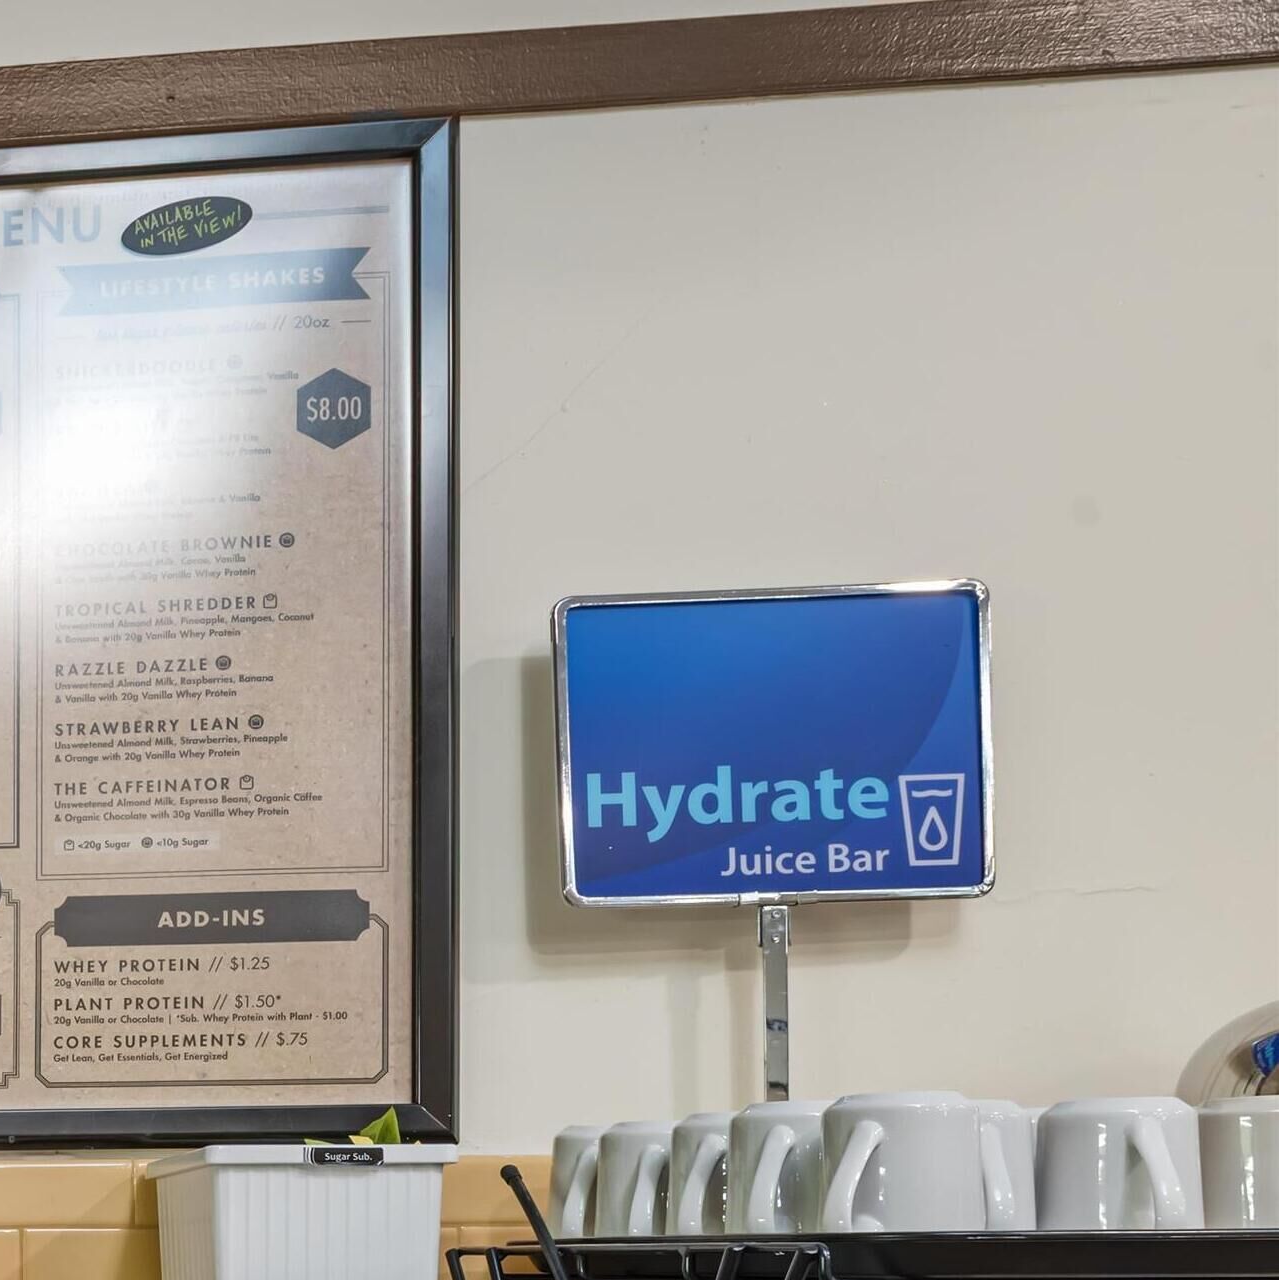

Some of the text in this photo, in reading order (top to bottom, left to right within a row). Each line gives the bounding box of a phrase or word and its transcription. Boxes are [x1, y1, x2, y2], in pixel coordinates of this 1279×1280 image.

[134, 199, 216, 235] AVAILABLE
[140, 204, 242, 249] IN THE VIEW!
[101, 267, 326, 298] LIFESTYLE SHAKES
[293, 315, 331, 329] 20oz
[306, 396, 362, 422] $8.00
[180, 535, 273, 552] BROWNIE
[55, 597, 256, 617] TROPICAL SHREDDER
[55, 658, 209, 677] RAZZLE DAZZLE
[55, 717, 240, 737] STRAWBERRY LEAN
[55, 733, 288, 750] Unsweetened Almond Milk, Strawberries, Pineapple
[55, 777, 231, 796] THE CAFFEINATOR
[587, 766, 890, 844] Hydrate
[721, 843, 890, 877] Juice Bar
[157, 908, 266, 928] ADD-INS
[54, 956, 270, 974] WHEY PROTEIN $1.25
[75, 977, 105, 987] Vanilla
[120, 976, 164, 987] Chocolate
[54, 997, 113, 1012] PLANT
[124, 996, 205, 1011] PROTEIN
[203, 1010, 348, 1024] Whey Protein with Plant $1.00
[54, 1031, 308, 1050] CORE SUPPLEMENTS $.75
[71, 1052, 95, 1063] Lean,
[117, 1051, 162, 1062] Essentials,
[184, 1050, 228, 1062] Energized
[324, 1151, 373, 1164] Sugar Sub.
